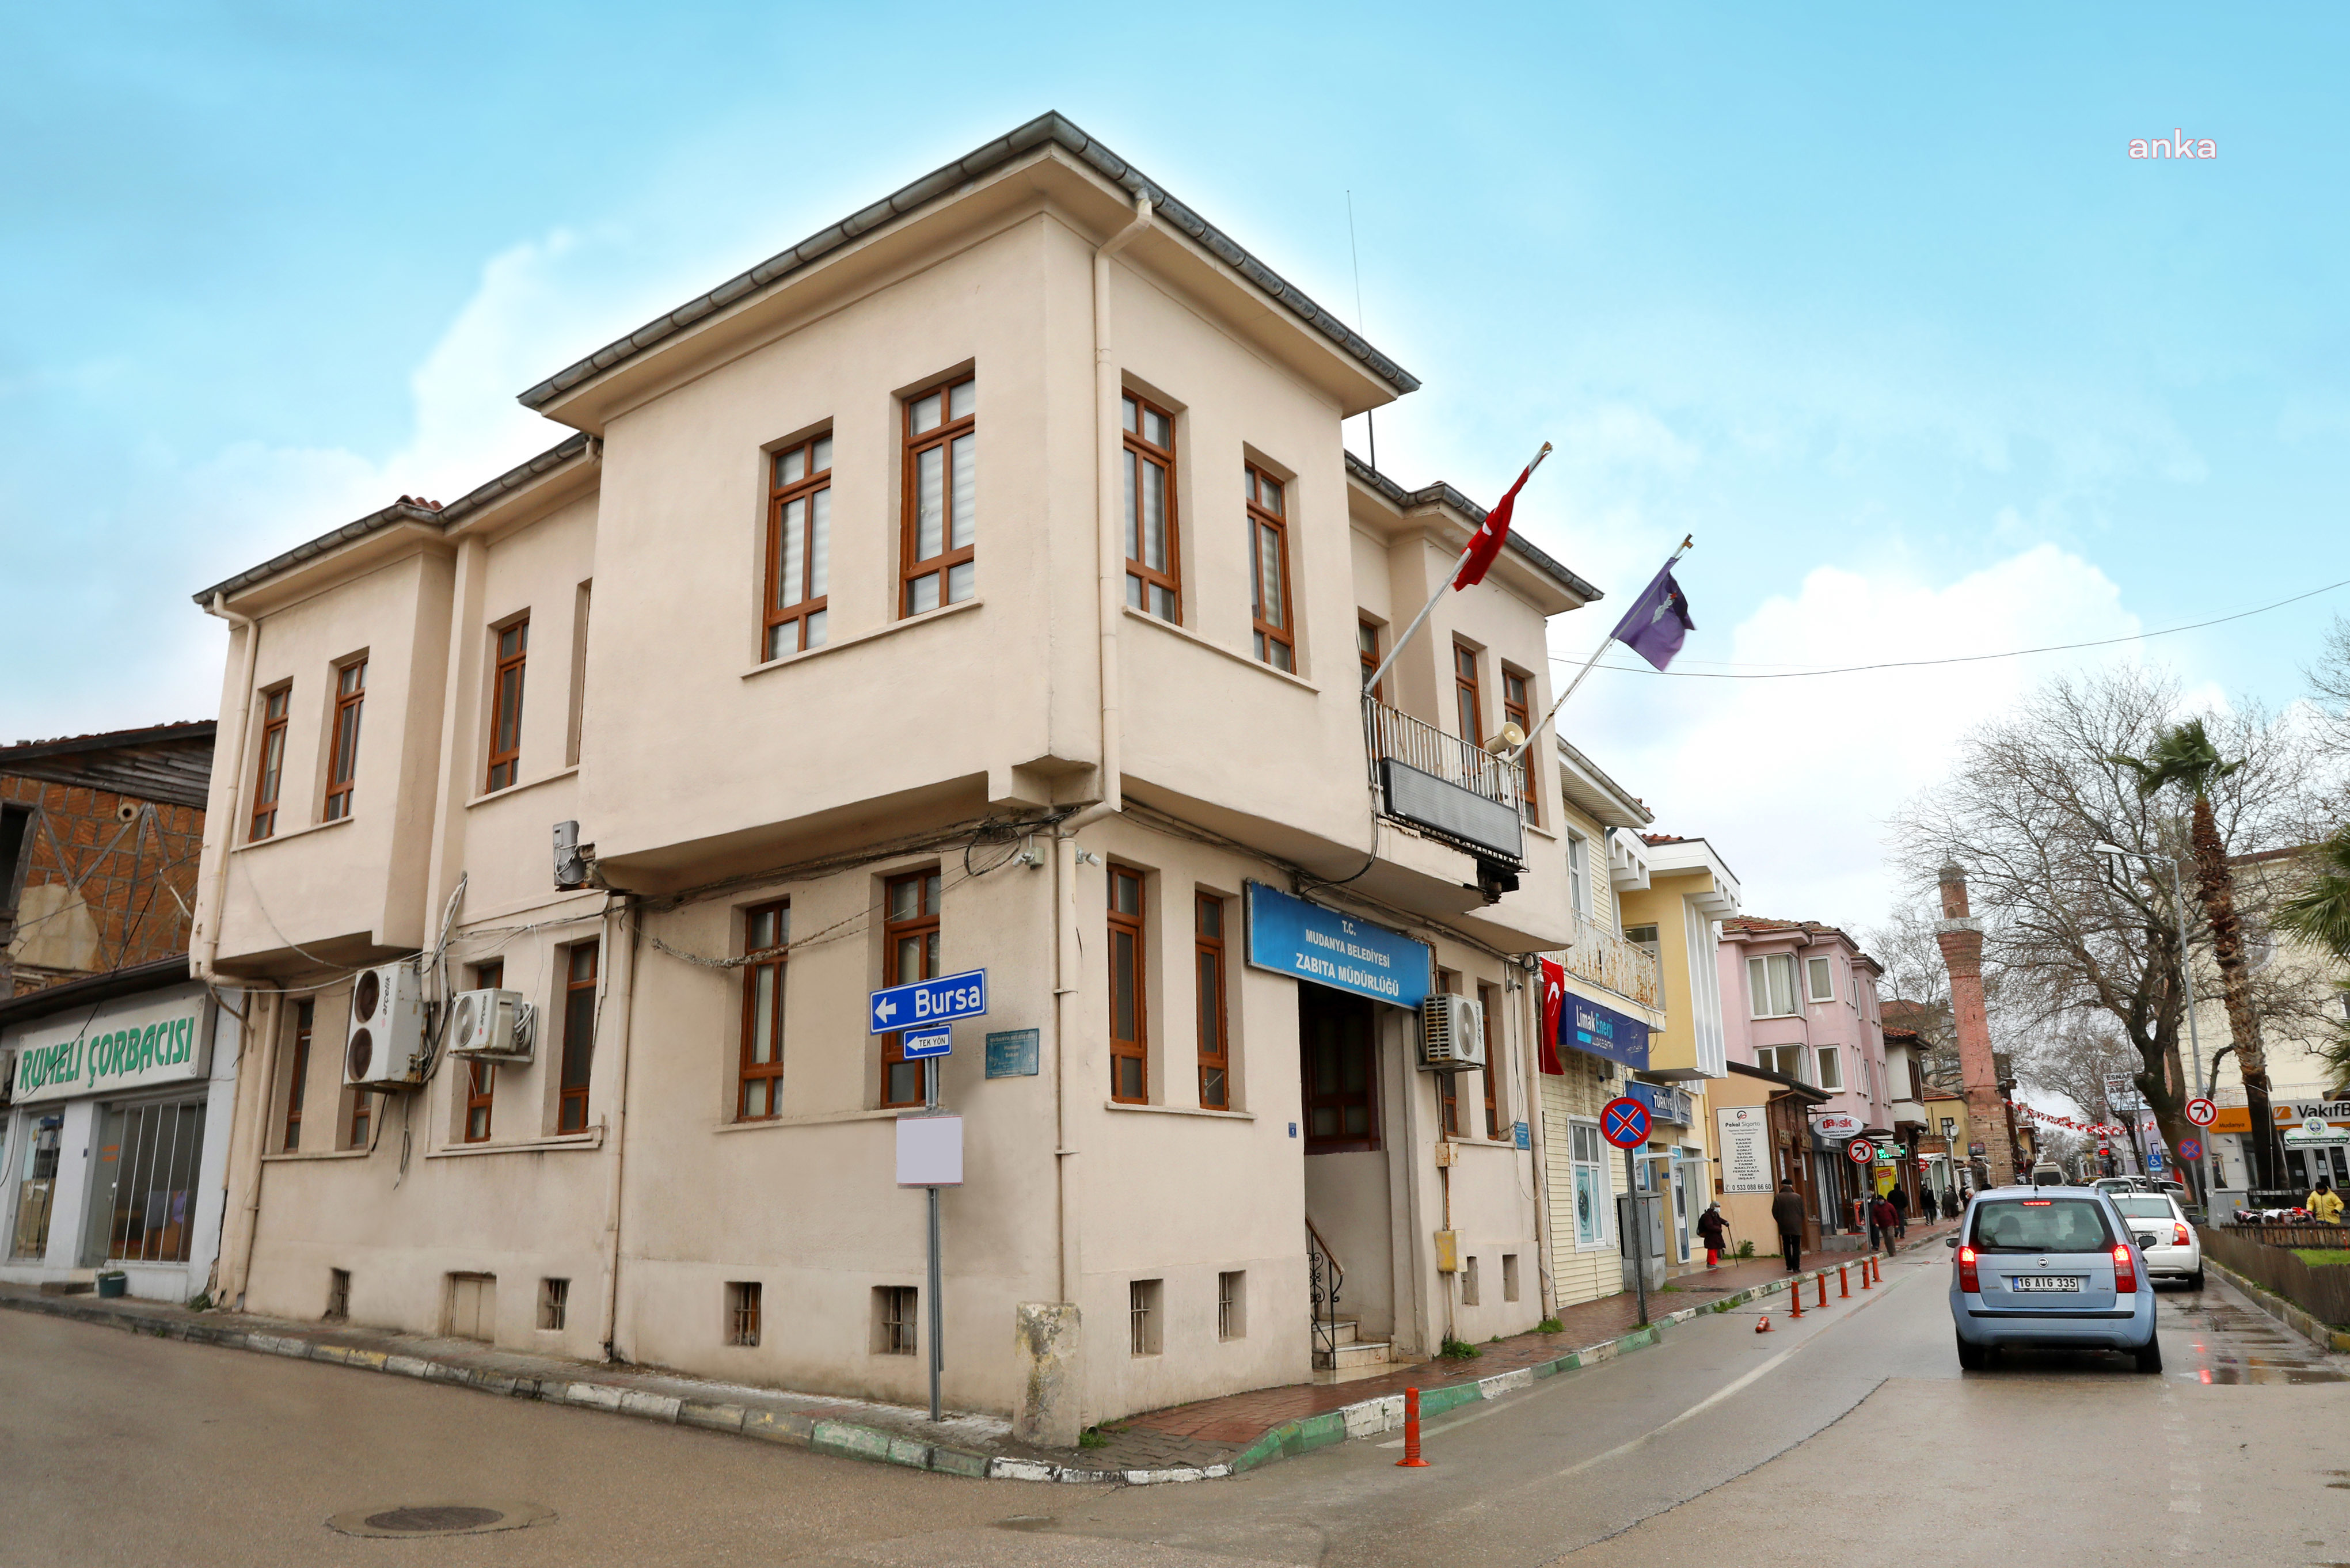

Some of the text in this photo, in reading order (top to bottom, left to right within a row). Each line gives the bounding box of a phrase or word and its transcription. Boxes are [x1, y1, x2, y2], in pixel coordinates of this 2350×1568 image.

[1342, 920, 1356, 936] T.C.
[1306, 929, 1390, 968] MUDANYA BELEDİYESİ
[1296, 952, 1399, 996] ZABITA MÜDÜRLÜĞÜ
[382, 975, 391, 1015] arçelik
[915, 985, 980, 1018] Bursa
[19, 1017, 195, 1093] RUMELİ ÇORBACISI
[919, 1036, 945, 1047] TEK YÖN
[2019, 1278, 2030, 1287] 16
[2035, 1278, 2053, 1287] AIG
[2057, 1278, 2075, 1287] 335
